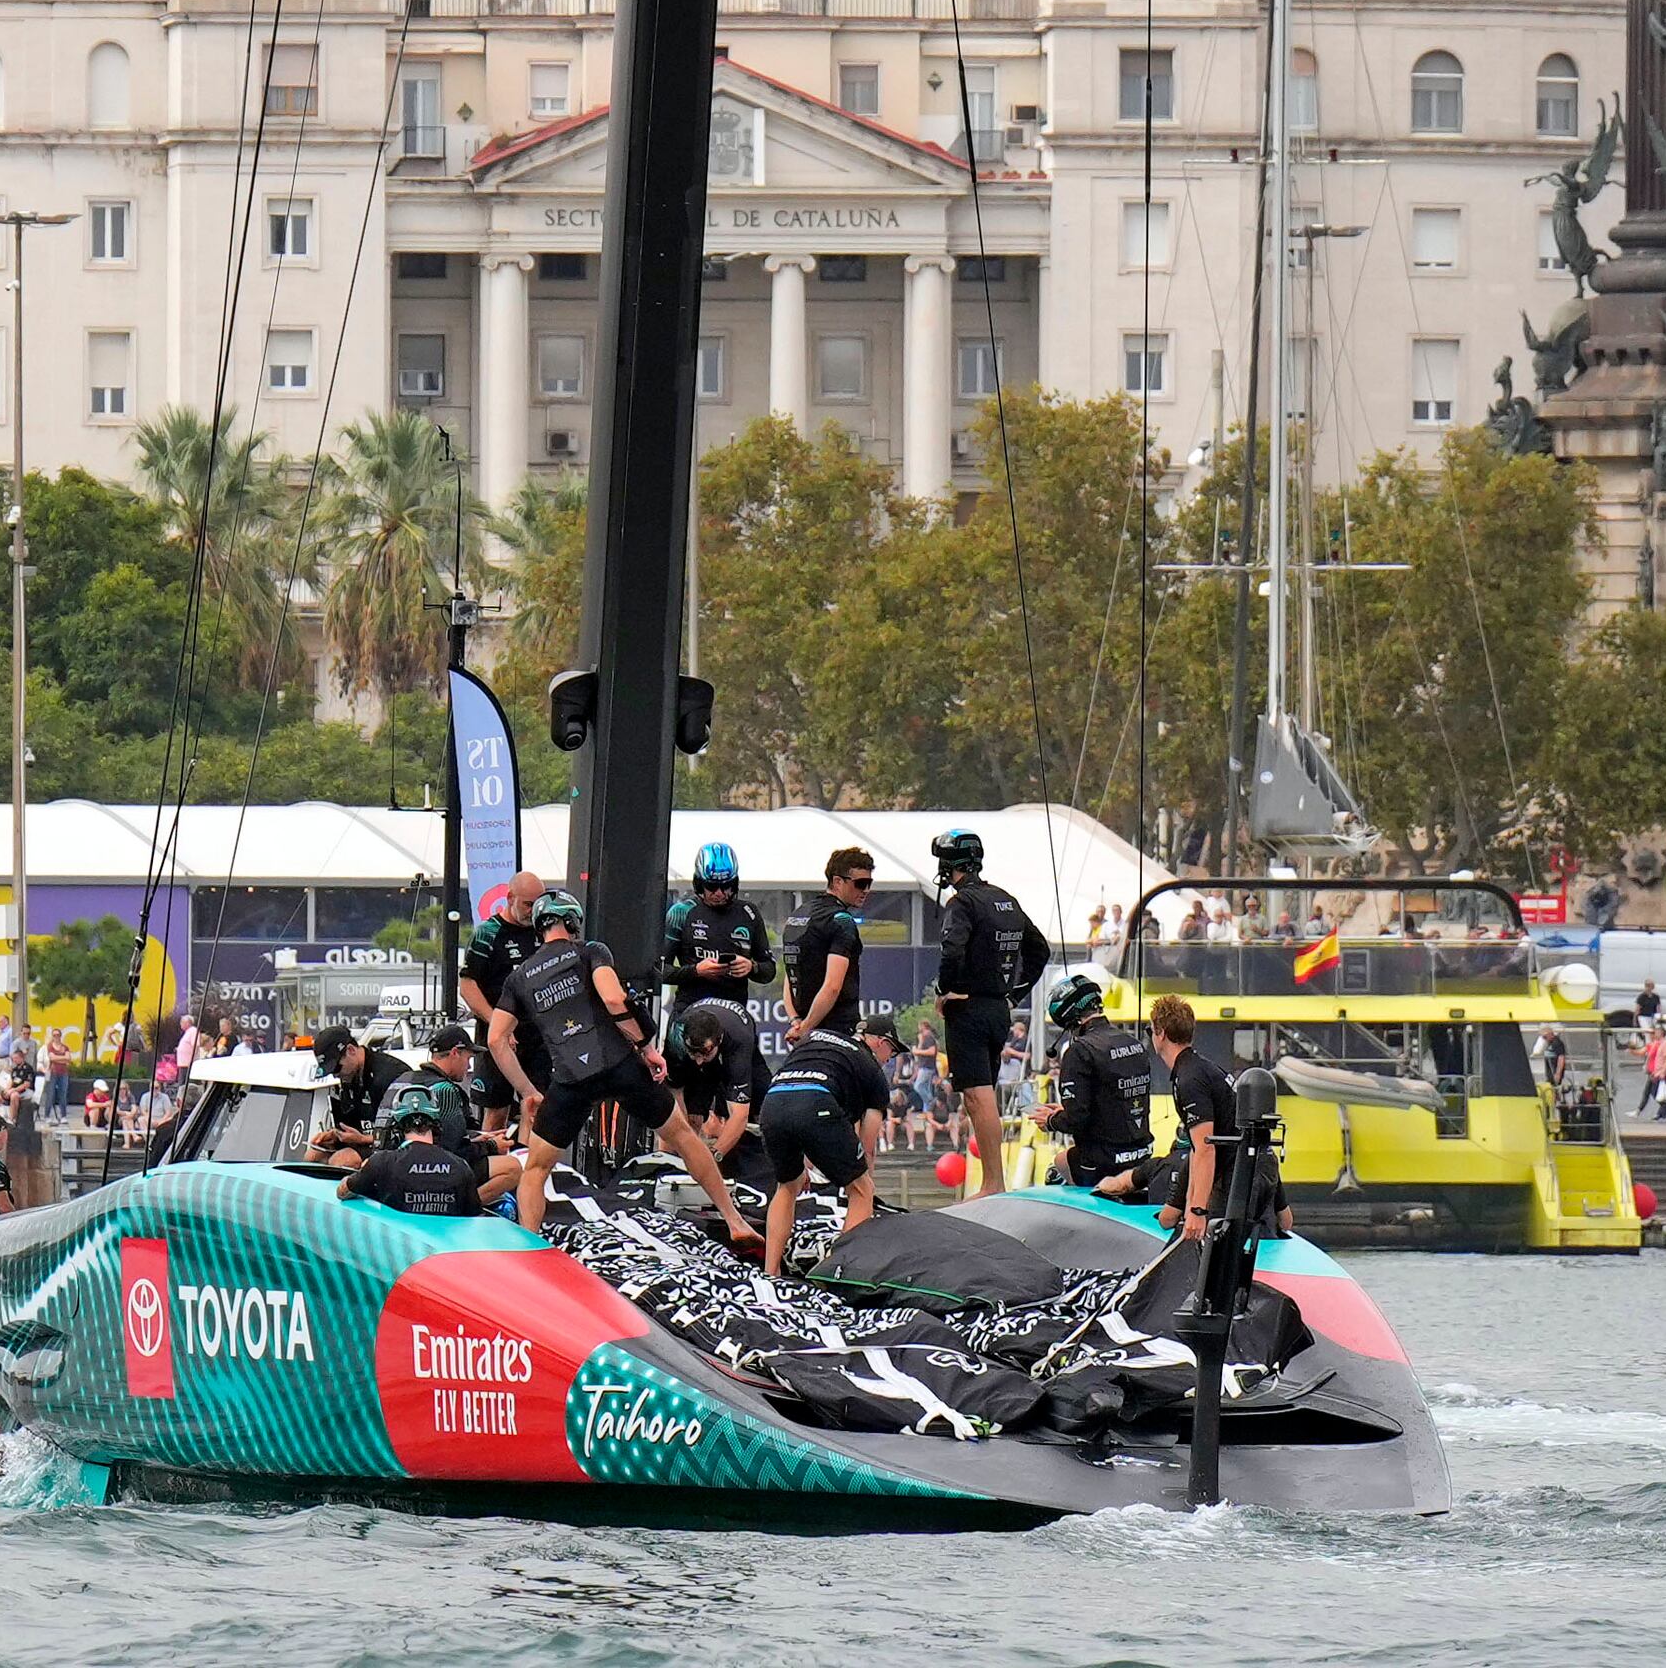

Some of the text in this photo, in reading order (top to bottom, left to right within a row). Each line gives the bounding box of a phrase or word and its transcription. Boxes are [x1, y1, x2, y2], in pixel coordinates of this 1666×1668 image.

[733, 210, 760, 227] DE
[774, 207, 900, 228] CATALUÑA
[994, 901, 1014, 911] TUKE
[525, 950, 577, 979] VAN DER POL
[534, 974, 580, 1003] Emirates
[1110, 1043, 1144, 1060] BURLING
[408, 1163, 451, 1174] ALLAN
[405, 1190, 455, 1203] Emirates
[178, 1285, 314, 1362] TOYOTA
[411, 1323, 532, 1382] Emirates
[434, 1390, 518, 1436] FLY BETTER
[581, 1383, 702, 1459] Taihoro
